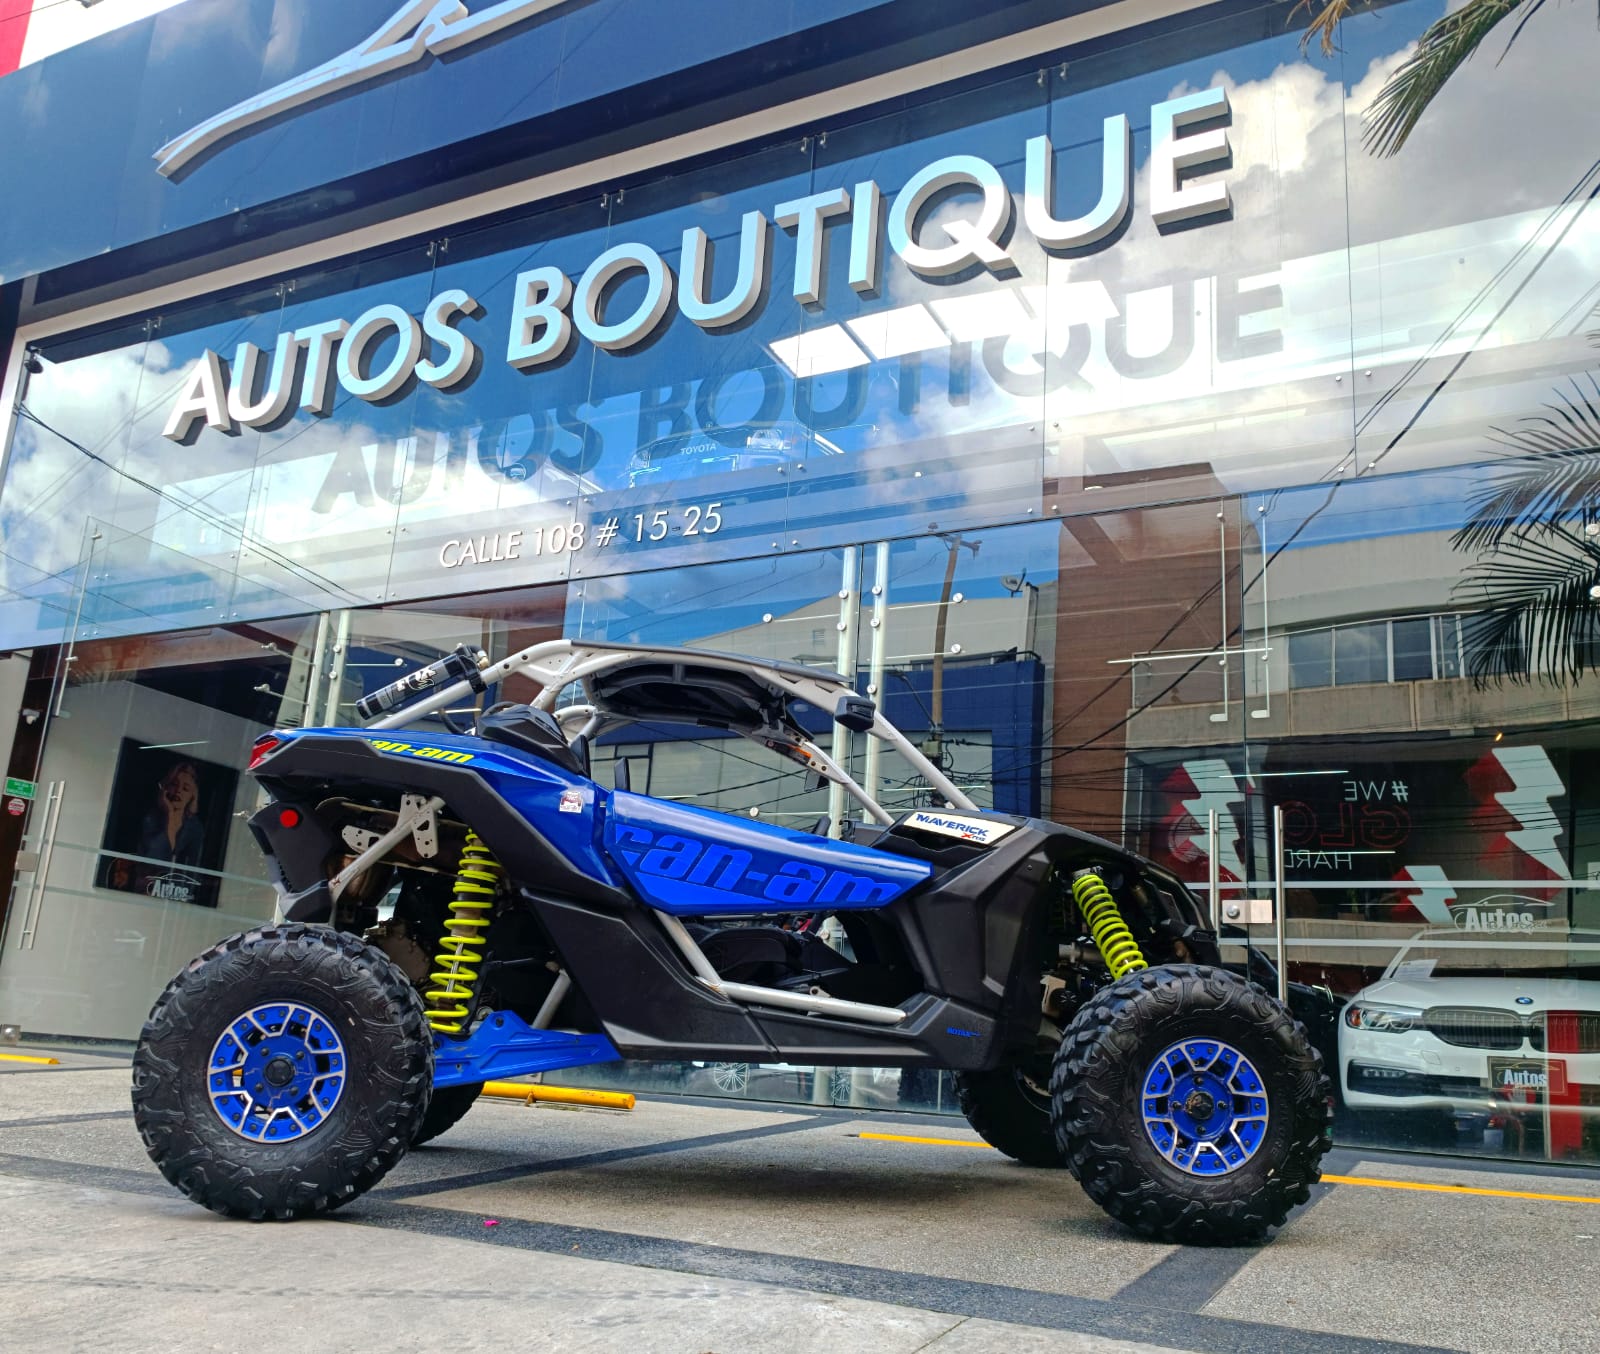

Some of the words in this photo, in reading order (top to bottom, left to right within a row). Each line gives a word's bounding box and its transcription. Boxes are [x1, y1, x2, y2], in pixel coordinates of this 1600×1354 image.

[161, 288, 479, 443] AUTOS
[506, 87, 1231, 368] BOUTIQUE
[680, 443, 717, 455] TOYOTA
[438, 530, 524, 569] CALLE
[534, 522, 586, 556] 108
[596, 517, 620, 548] #
[367, 738, 475, 764] an-am
[915, 813, 990, 837] MAVERICK
[615, 823, 901, 904] can-am
[1465, 907, 1535, 932] Autos
[1503, 1069, 1548, 1087] Autos
